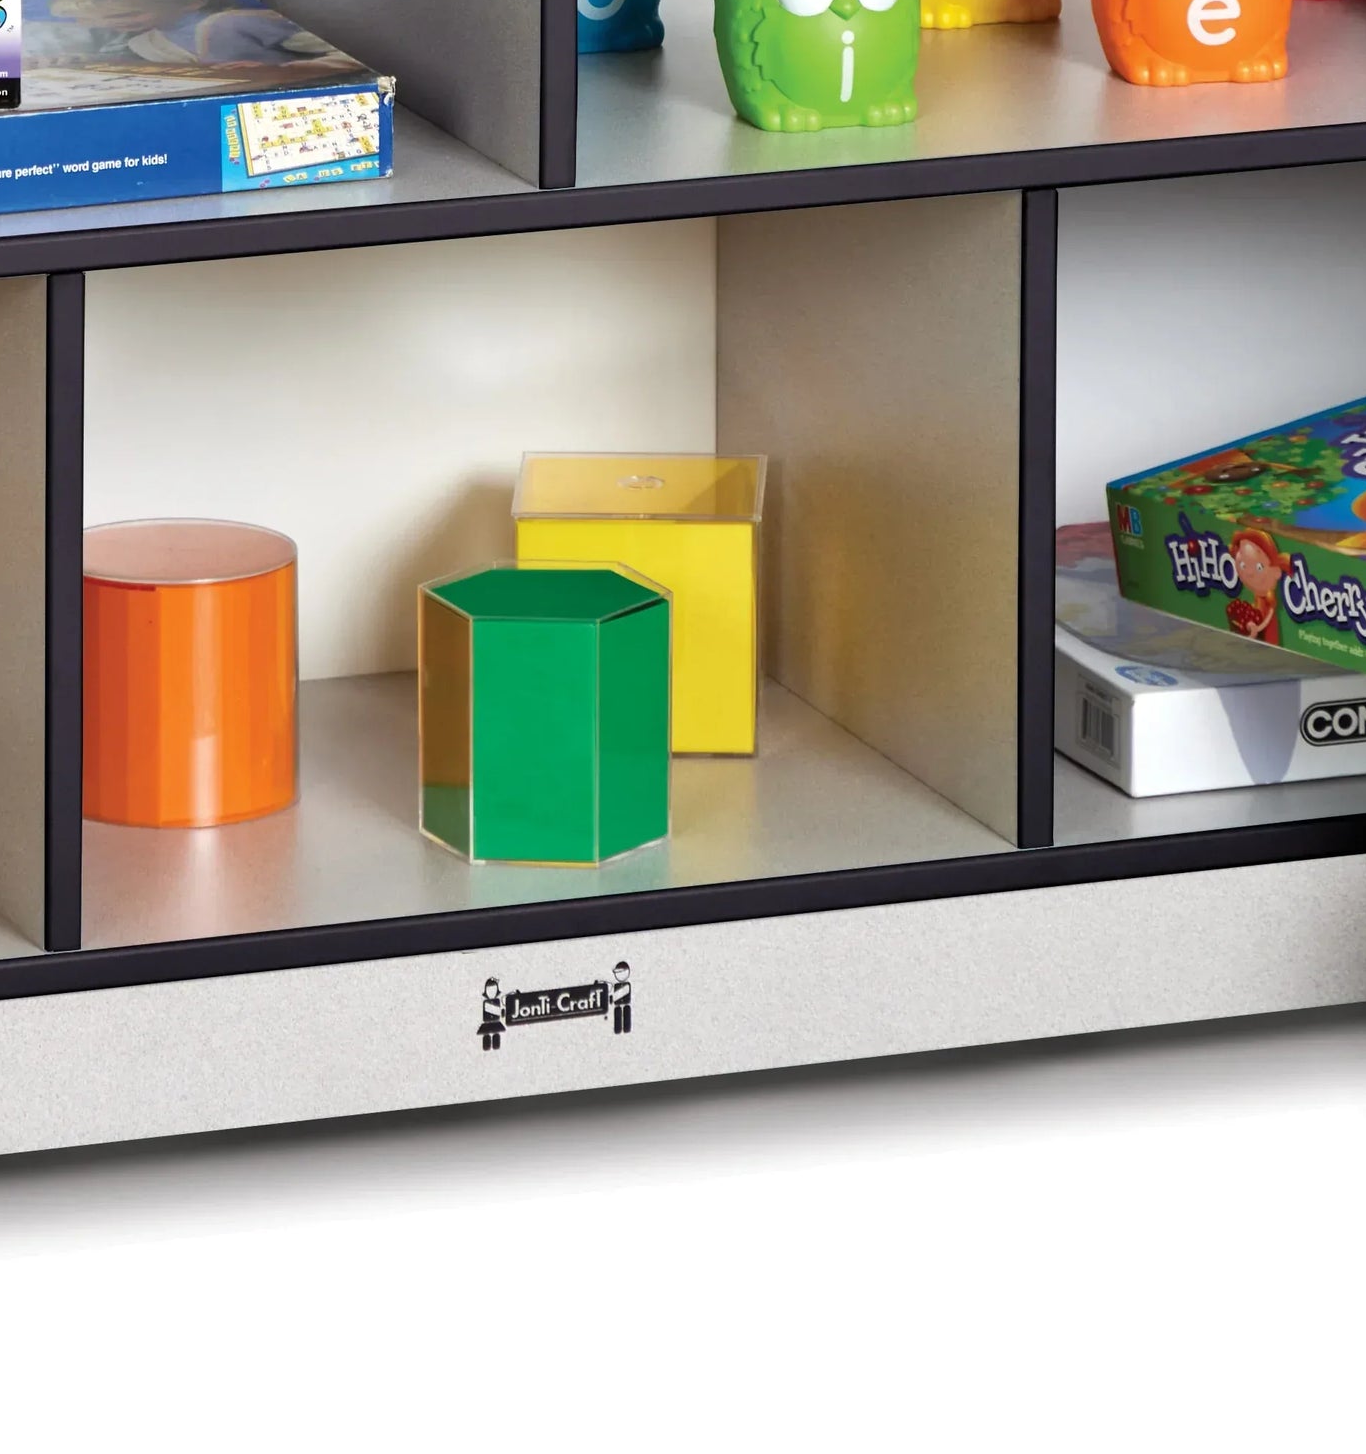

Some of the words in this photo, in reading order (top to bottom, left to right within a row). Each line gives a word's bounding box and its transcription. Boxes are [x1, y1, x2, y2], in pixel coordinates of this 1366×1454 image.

[841, 30, 855, 103] i
[63, 161, 90, 173] word
[92, 160, 122, 173] game
[124, 157, 140, 167] for
[142, 154, 168, 166] kids!
[1117, 504, 1142, 535] MB
